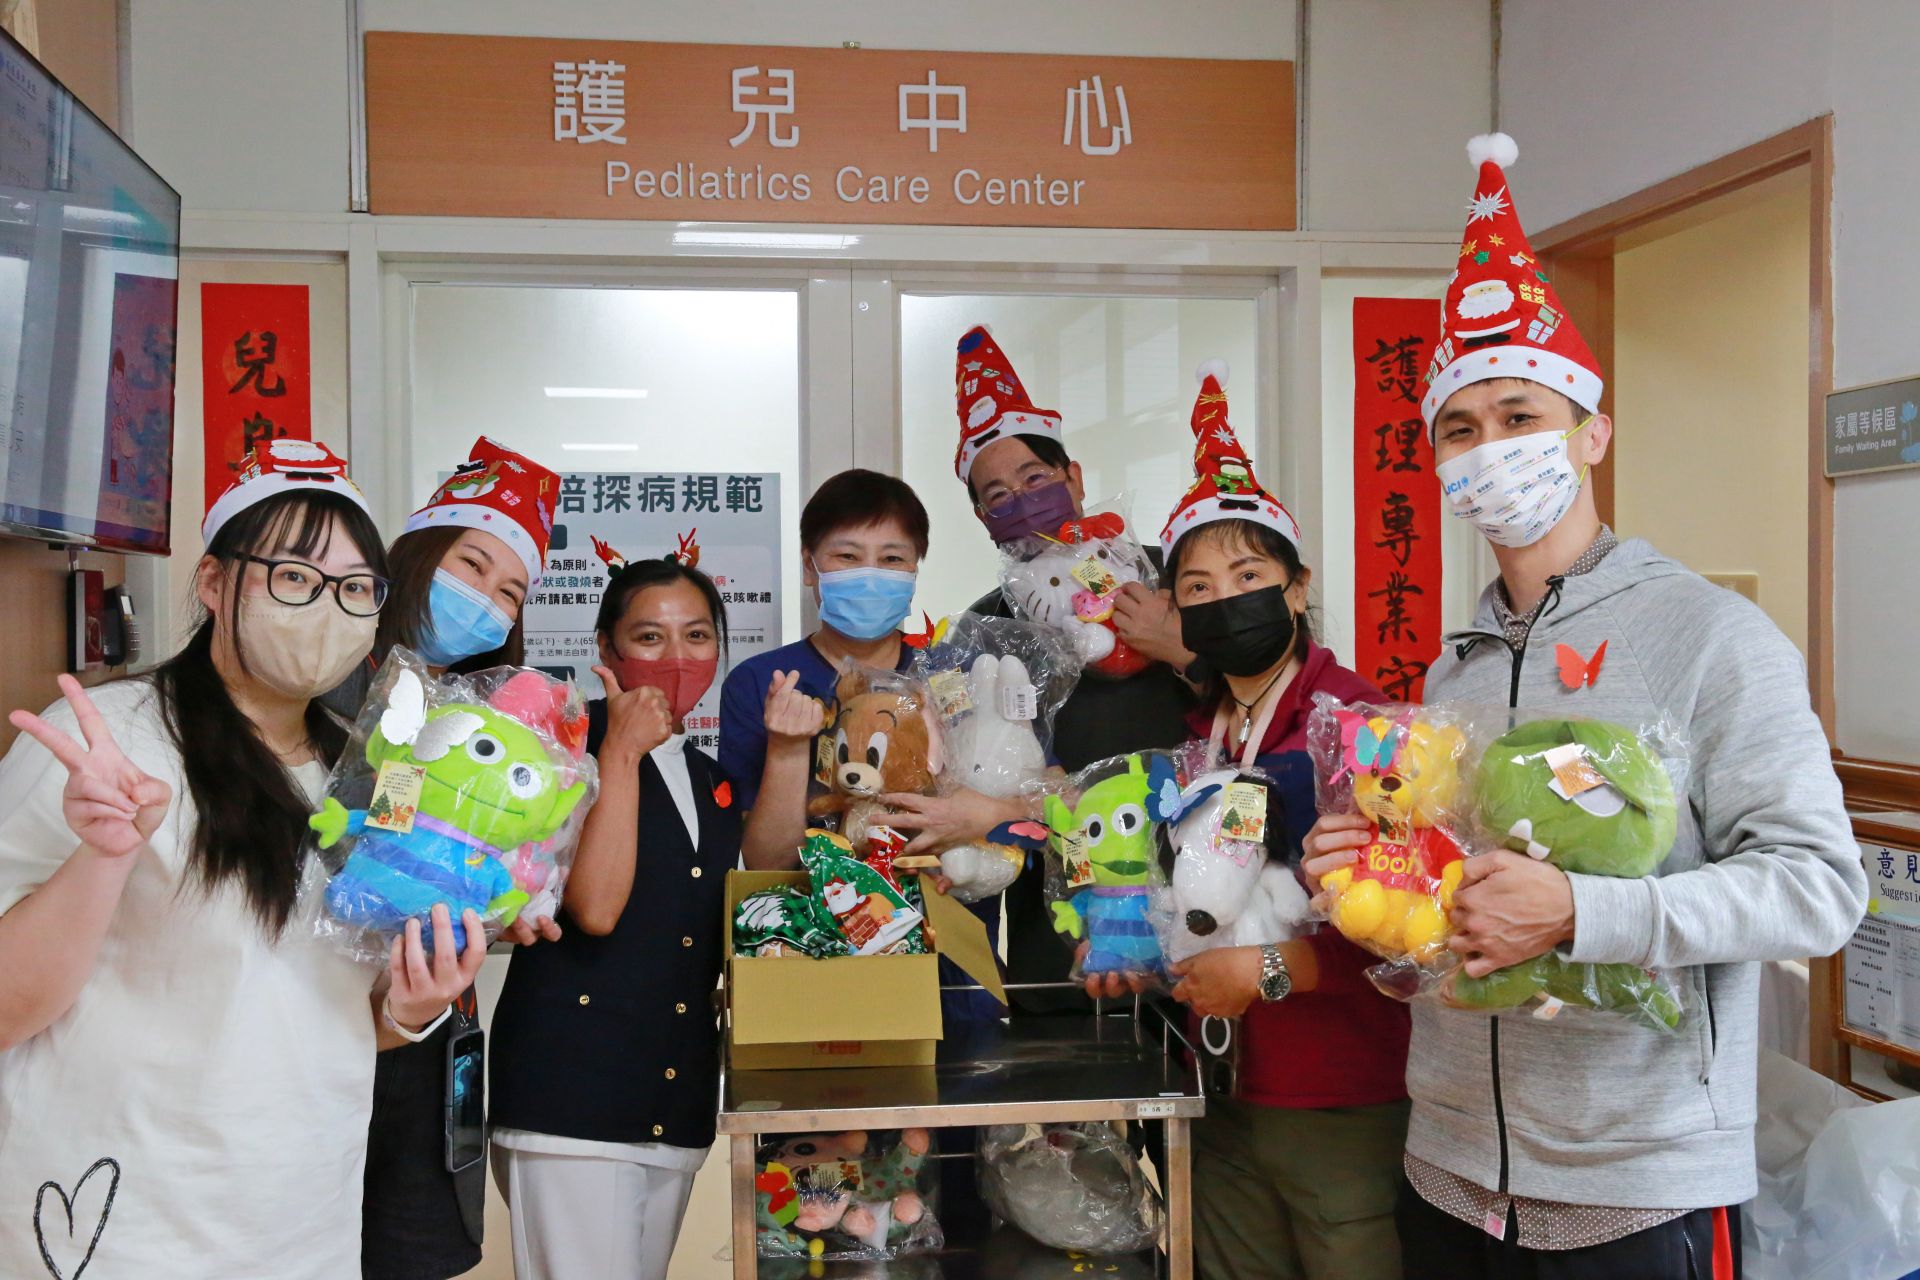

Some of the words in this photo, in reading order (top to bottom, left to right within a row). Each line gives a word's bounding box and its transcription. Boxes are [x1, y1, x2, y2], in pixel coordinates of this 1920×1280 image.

[553, 59, 1132, 156] 護兒中心
[605, 161, 812, 202] Pediatrics
[835, 166, 931, 203] Care
[953, 170, 1086, 207] Center
[1835, 406, 1896, 438] 家屬等候區
[1835, 444, 1855, 454] Family
[1856, 440, 1879, 452] Waiting
[1881, 438, 1897, 448] Area
[1877, 848, 1920, 884] 意見
